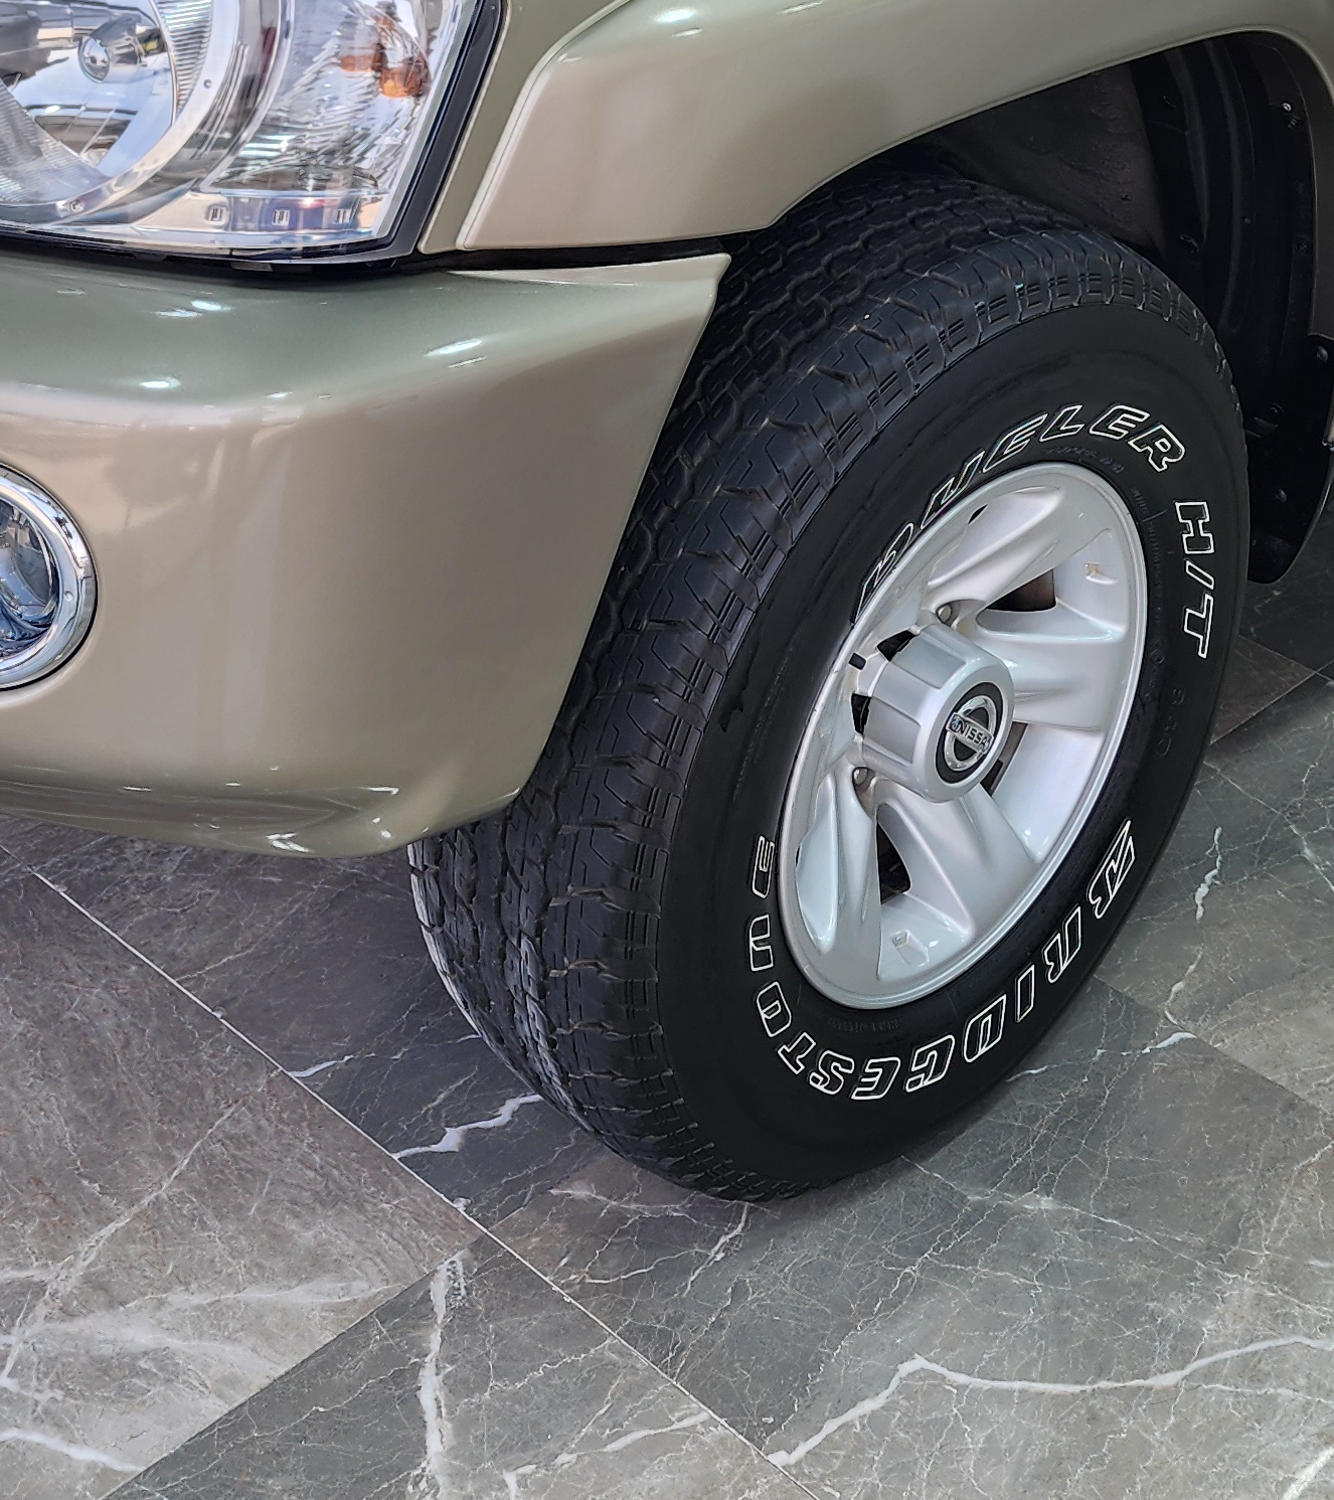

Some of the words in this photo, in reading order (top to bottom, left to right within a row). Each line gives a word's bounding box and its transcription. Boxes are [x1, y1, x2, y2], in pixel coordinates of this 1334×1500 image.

[852, 403, 1186, 625] DUELER
[1174, 500, 1216, 659] H/T
[955, 718, 992, 750] NISSA
[747, 818, 1137, 1101] BRIDGESTONE
